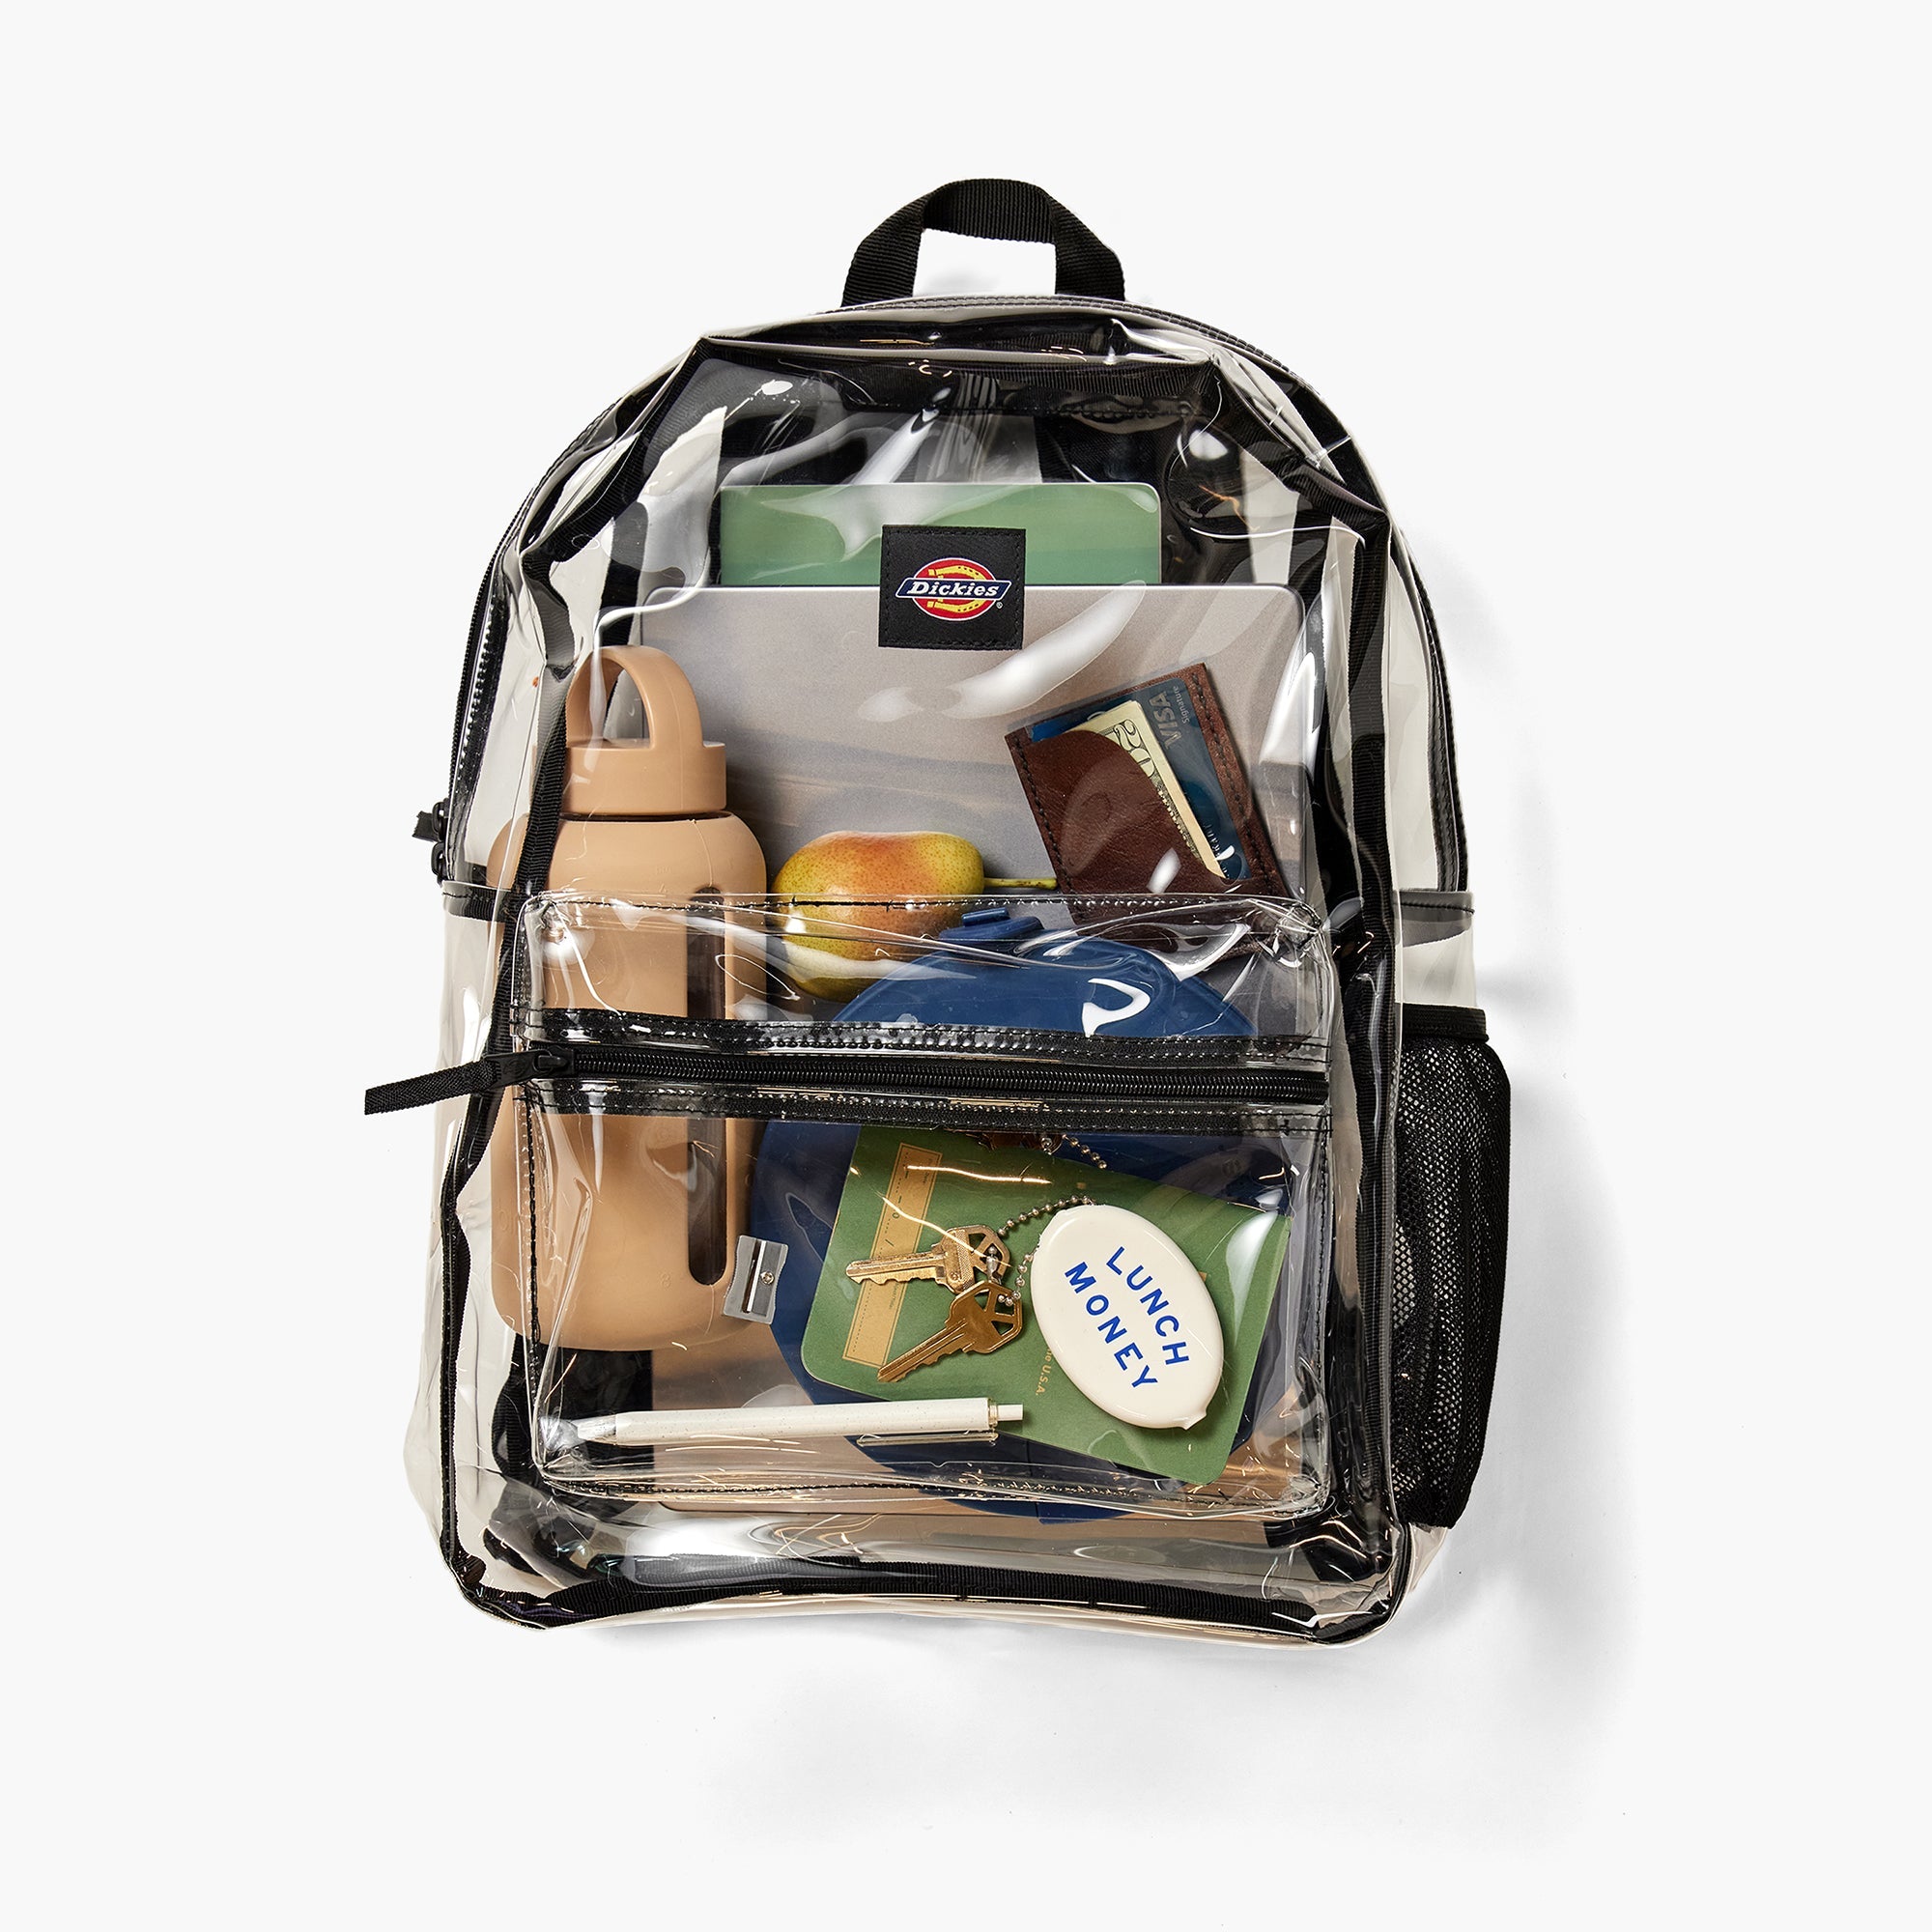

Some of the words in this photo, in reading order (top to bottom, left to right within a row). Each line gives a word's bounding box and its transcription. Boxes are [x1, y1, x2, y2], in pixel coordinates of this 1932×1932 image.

[907, 582, 999, 596] Dickies
[1149, 691, 1181, 750] VISA
[1173, 686, 1189, 724] Signature
[1065, 1262, 1158, 1388] MONEY
[1106, 1246, 1189, 1365] LUNCH
